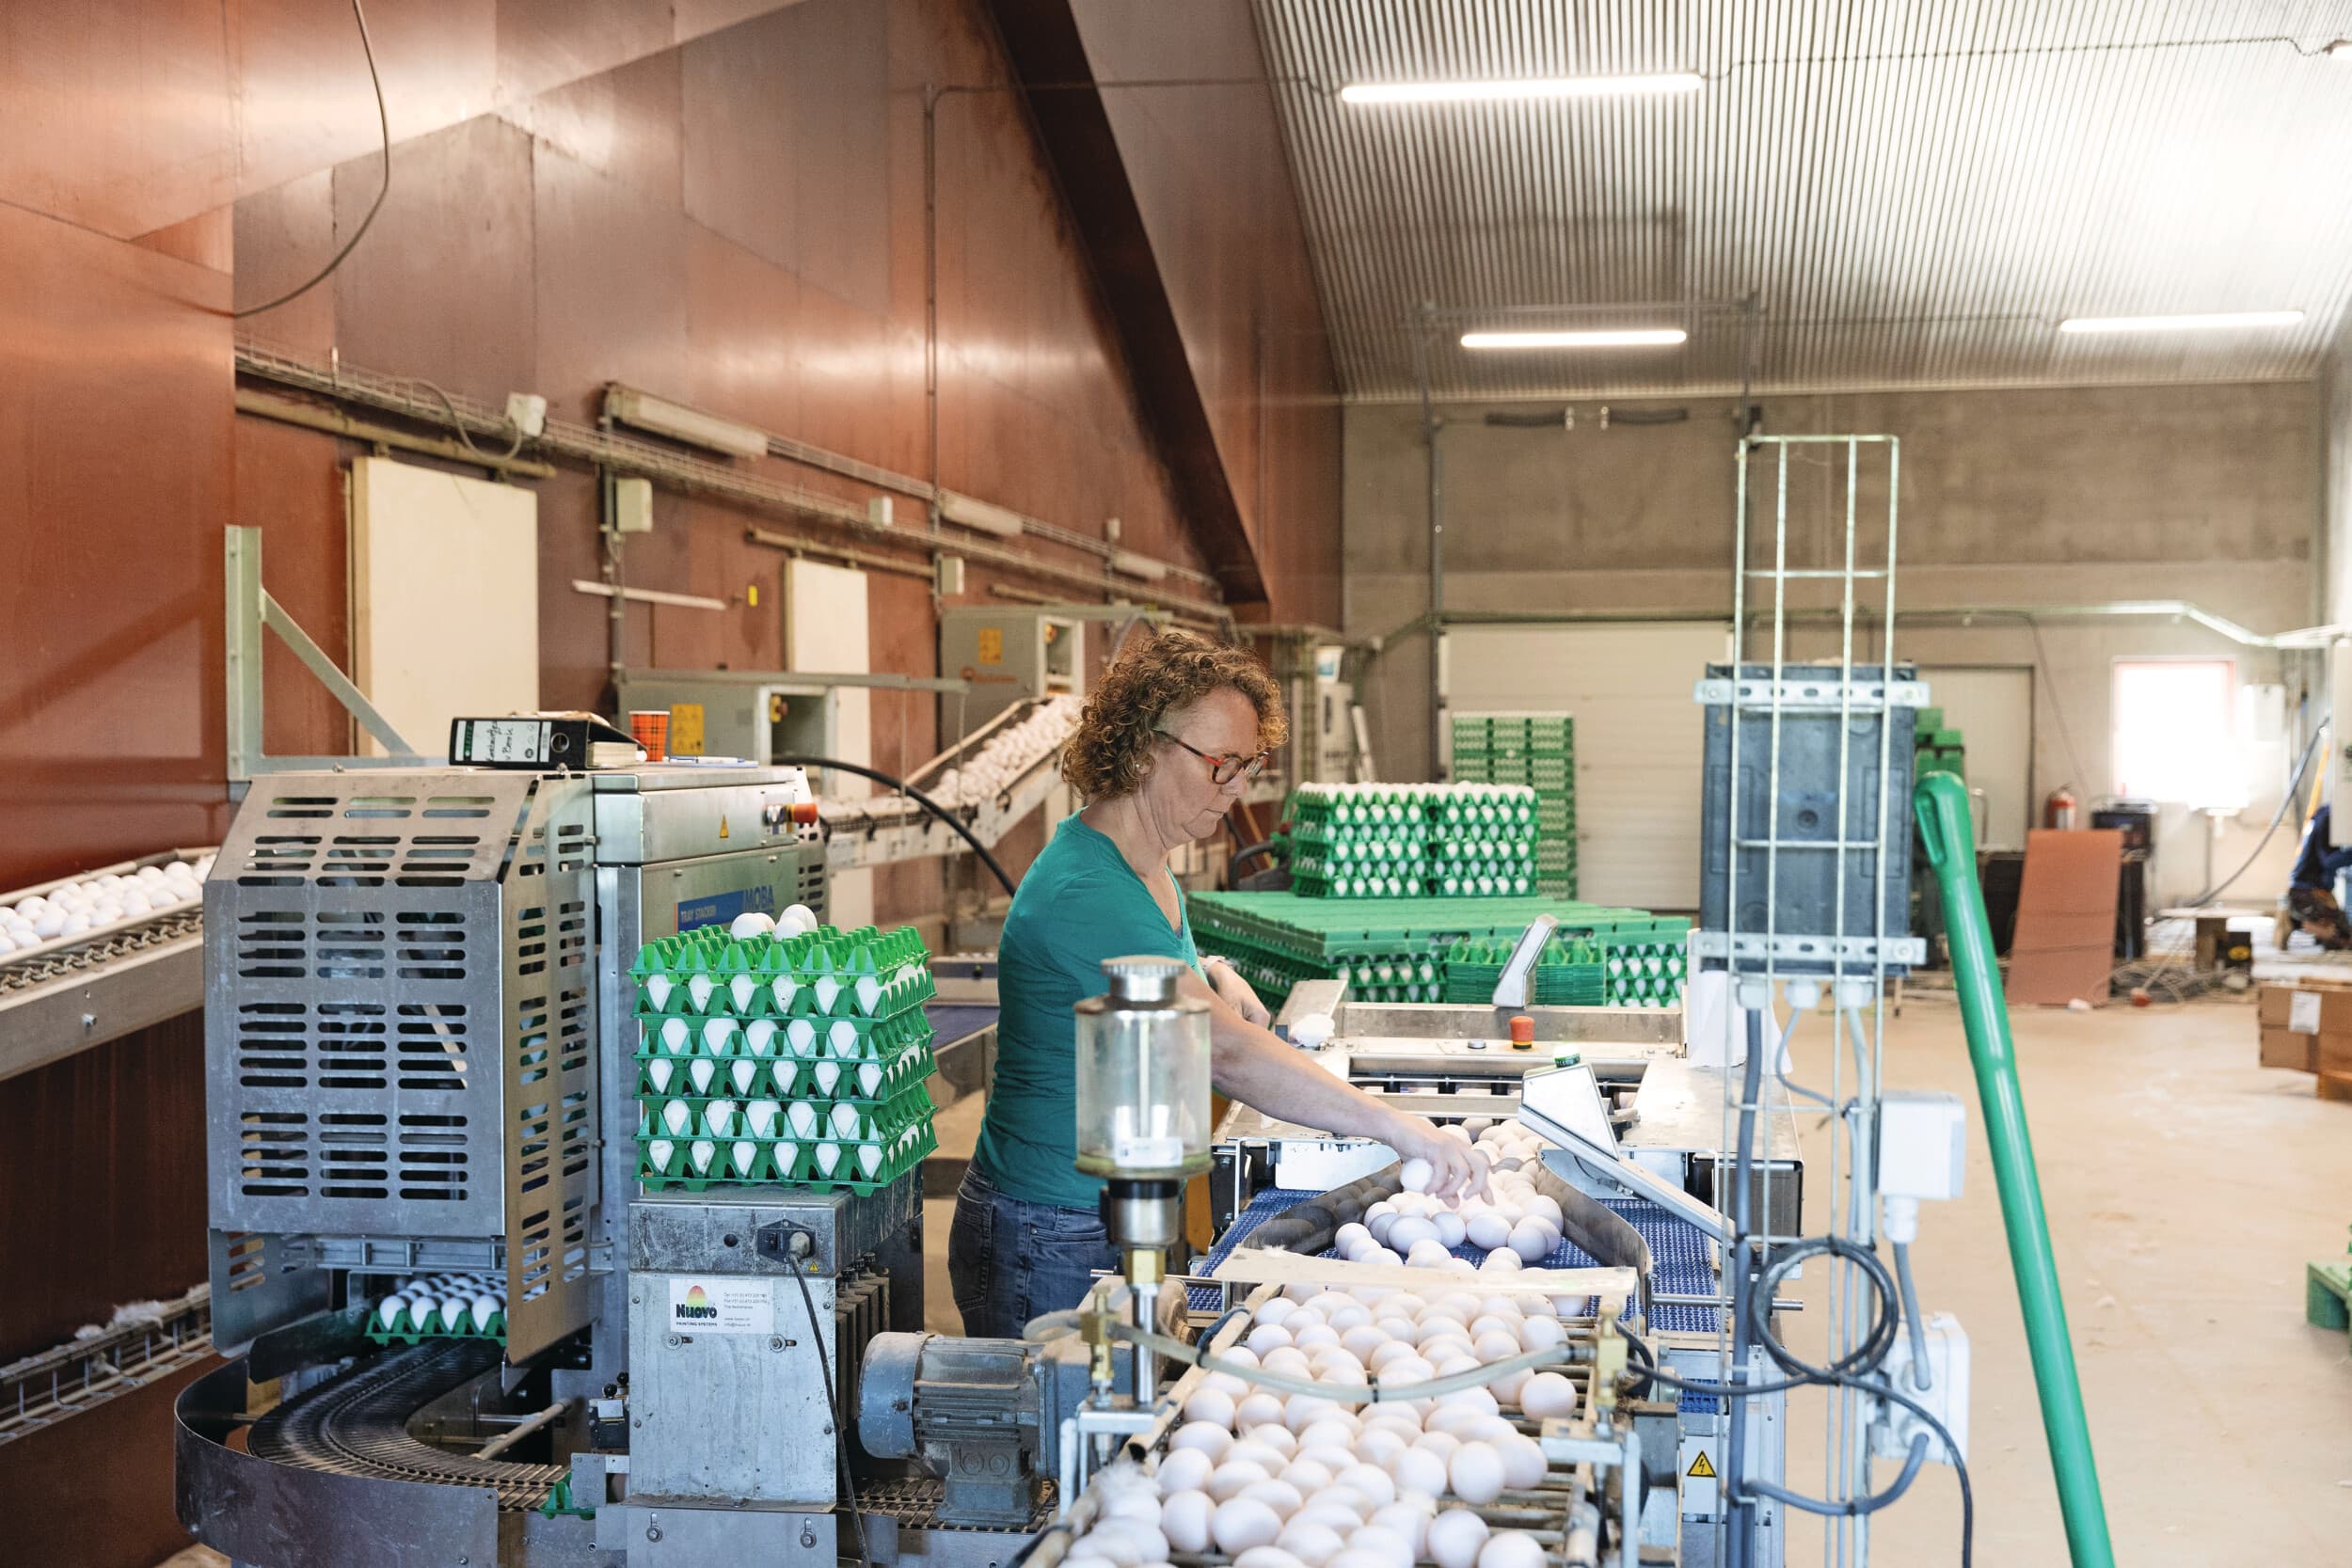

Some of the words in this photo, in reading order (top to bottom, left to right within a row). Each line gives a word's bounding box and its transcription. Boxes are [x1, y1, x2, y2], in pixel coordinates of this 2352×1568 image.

[744, 885, 774, 911] MOBA
[680, 910, 693, 923] TRAY
[675, 1304, 718, 1318] Nuovo
